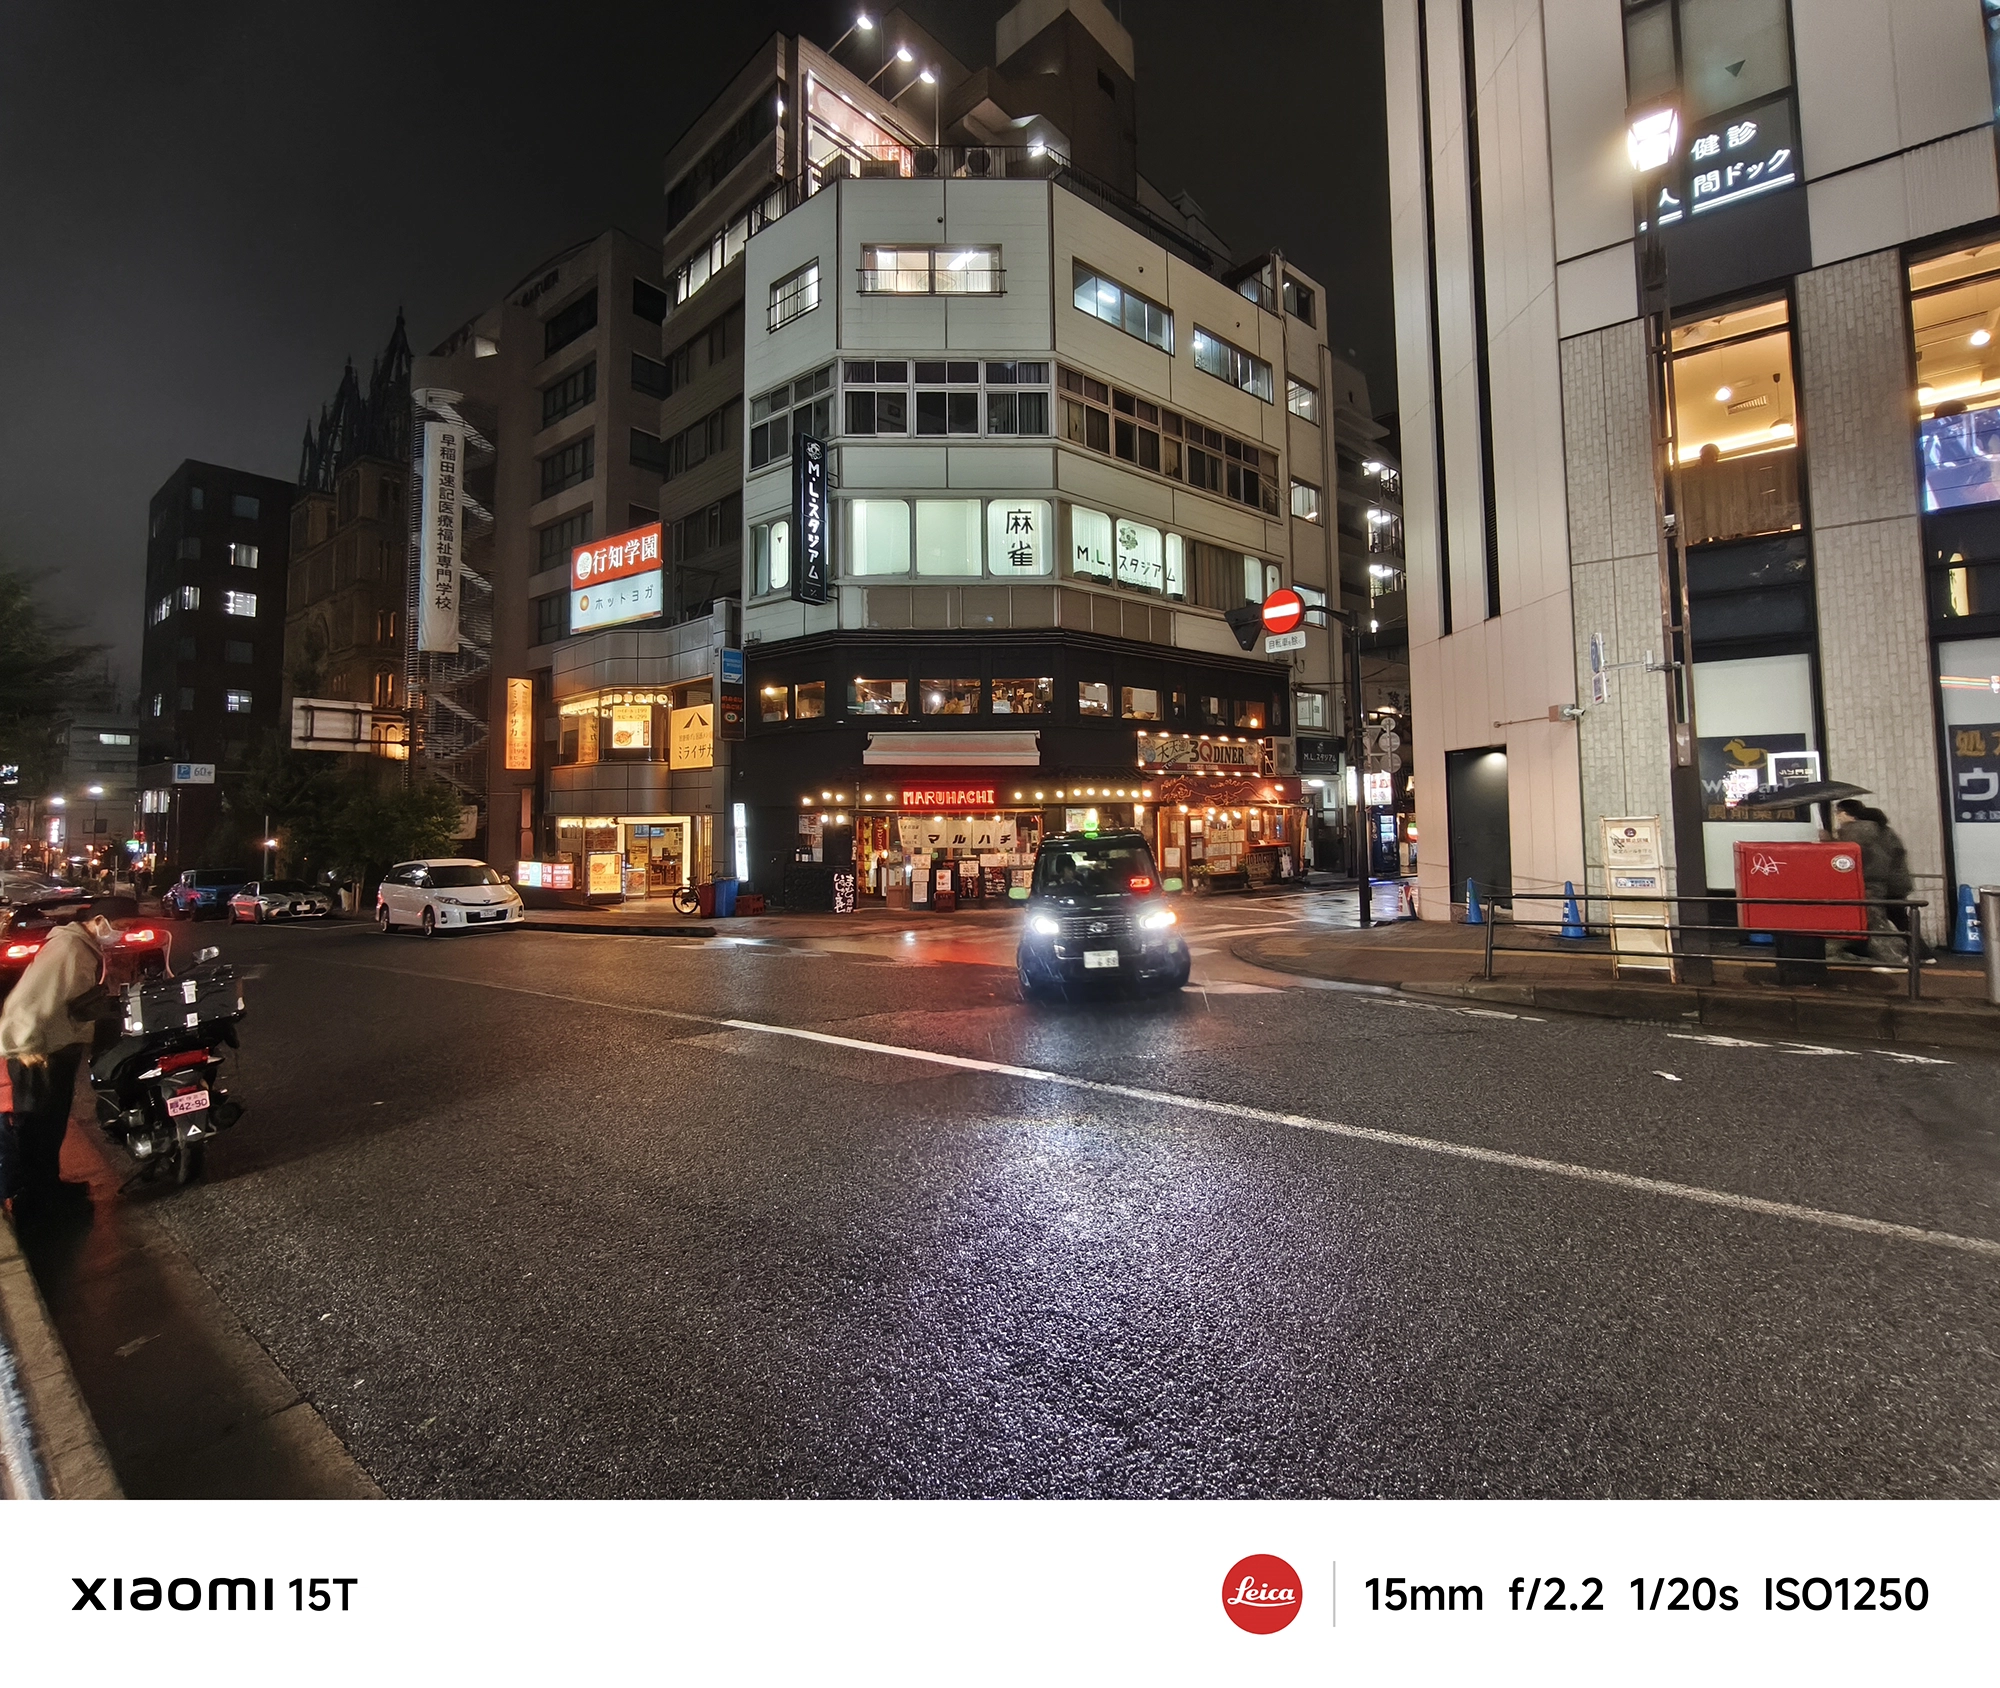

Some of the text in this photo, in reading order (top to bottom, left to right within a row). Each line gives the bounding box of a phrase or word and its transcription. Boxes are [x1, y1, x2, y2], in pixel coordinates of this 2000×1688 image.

[1690, 121, 1758, 161] 健診
[435, 433, 456, 610] 早稲田速記医療福祉専門学校
[1005, 509, 1034, 567] 麻雀
[592, 533, 659, 575] 行知学園
[595, 584, 654, 610] ホットヨガ
[1213, 745, 1245, 765] DINER
[902, 789, 995, 805] MARUHACHI
[927, 834, 1011, 845] マルハチ
[178, 1098, 208, 1111] 42-90
